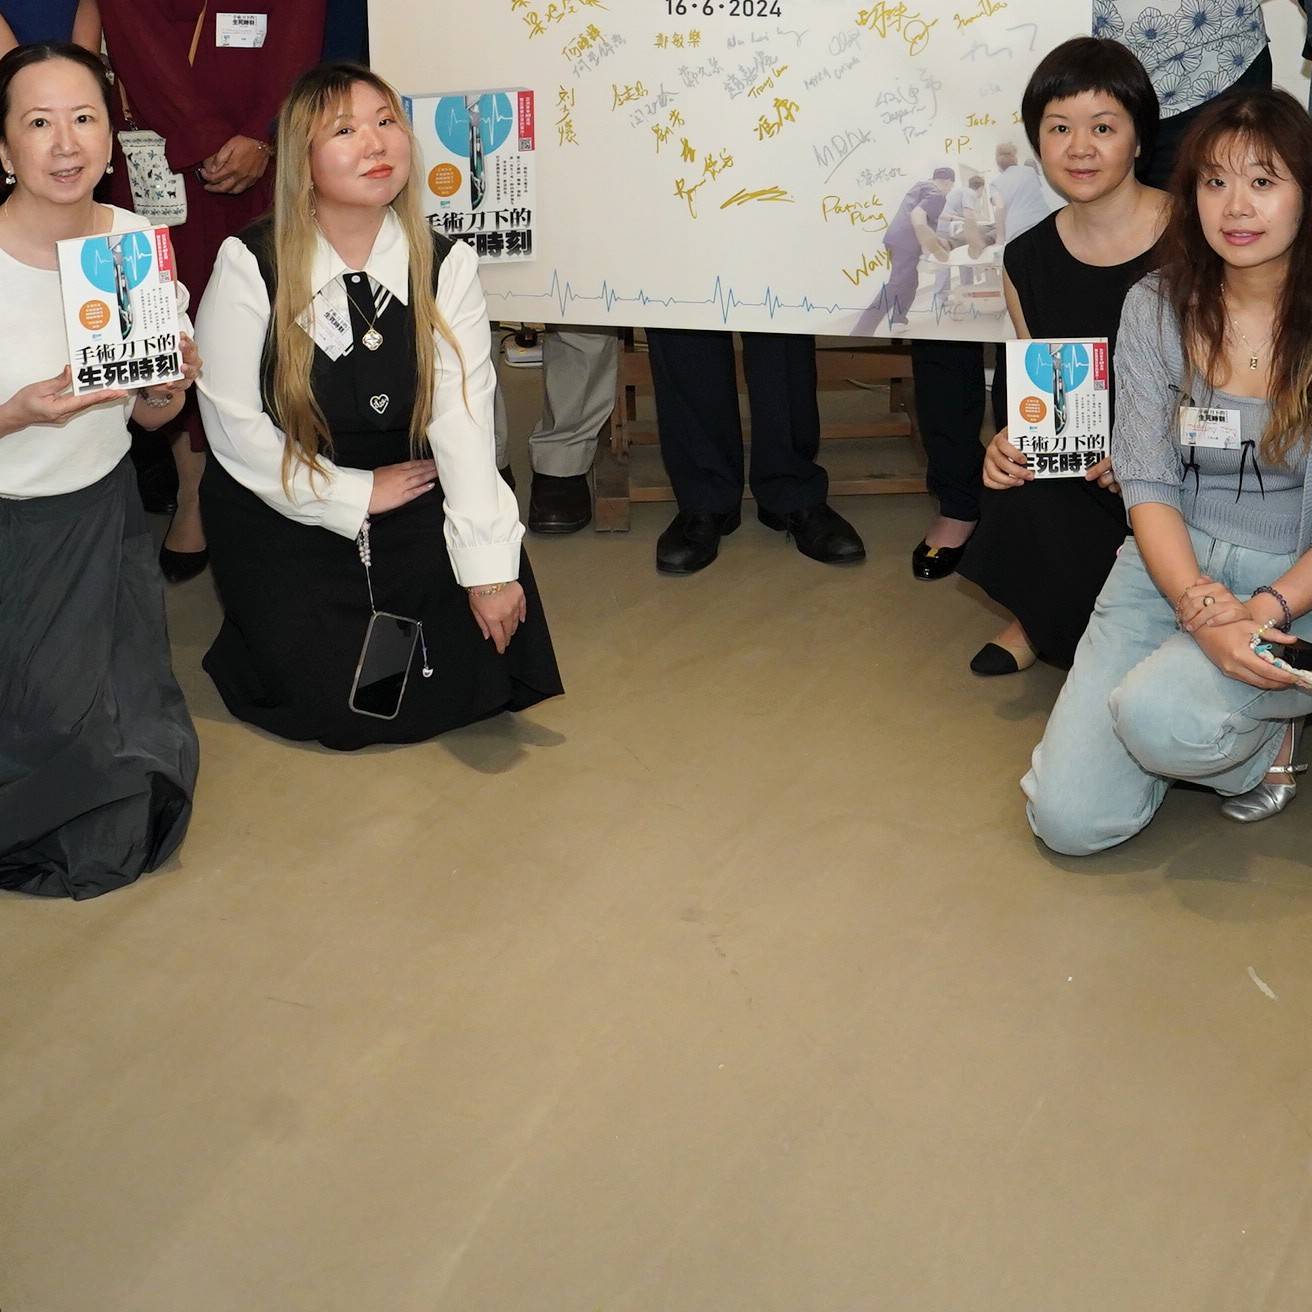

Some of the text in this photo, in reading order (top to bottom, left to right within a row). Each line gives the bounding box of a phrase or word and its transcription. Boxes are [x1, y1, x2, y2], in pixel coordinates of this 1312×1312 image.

[75, 333, 176, 365] 手術刀下的
[77, 352, 179, 392] 生死時刻
[1013, 434, 1105, 452] 手術刀下的
